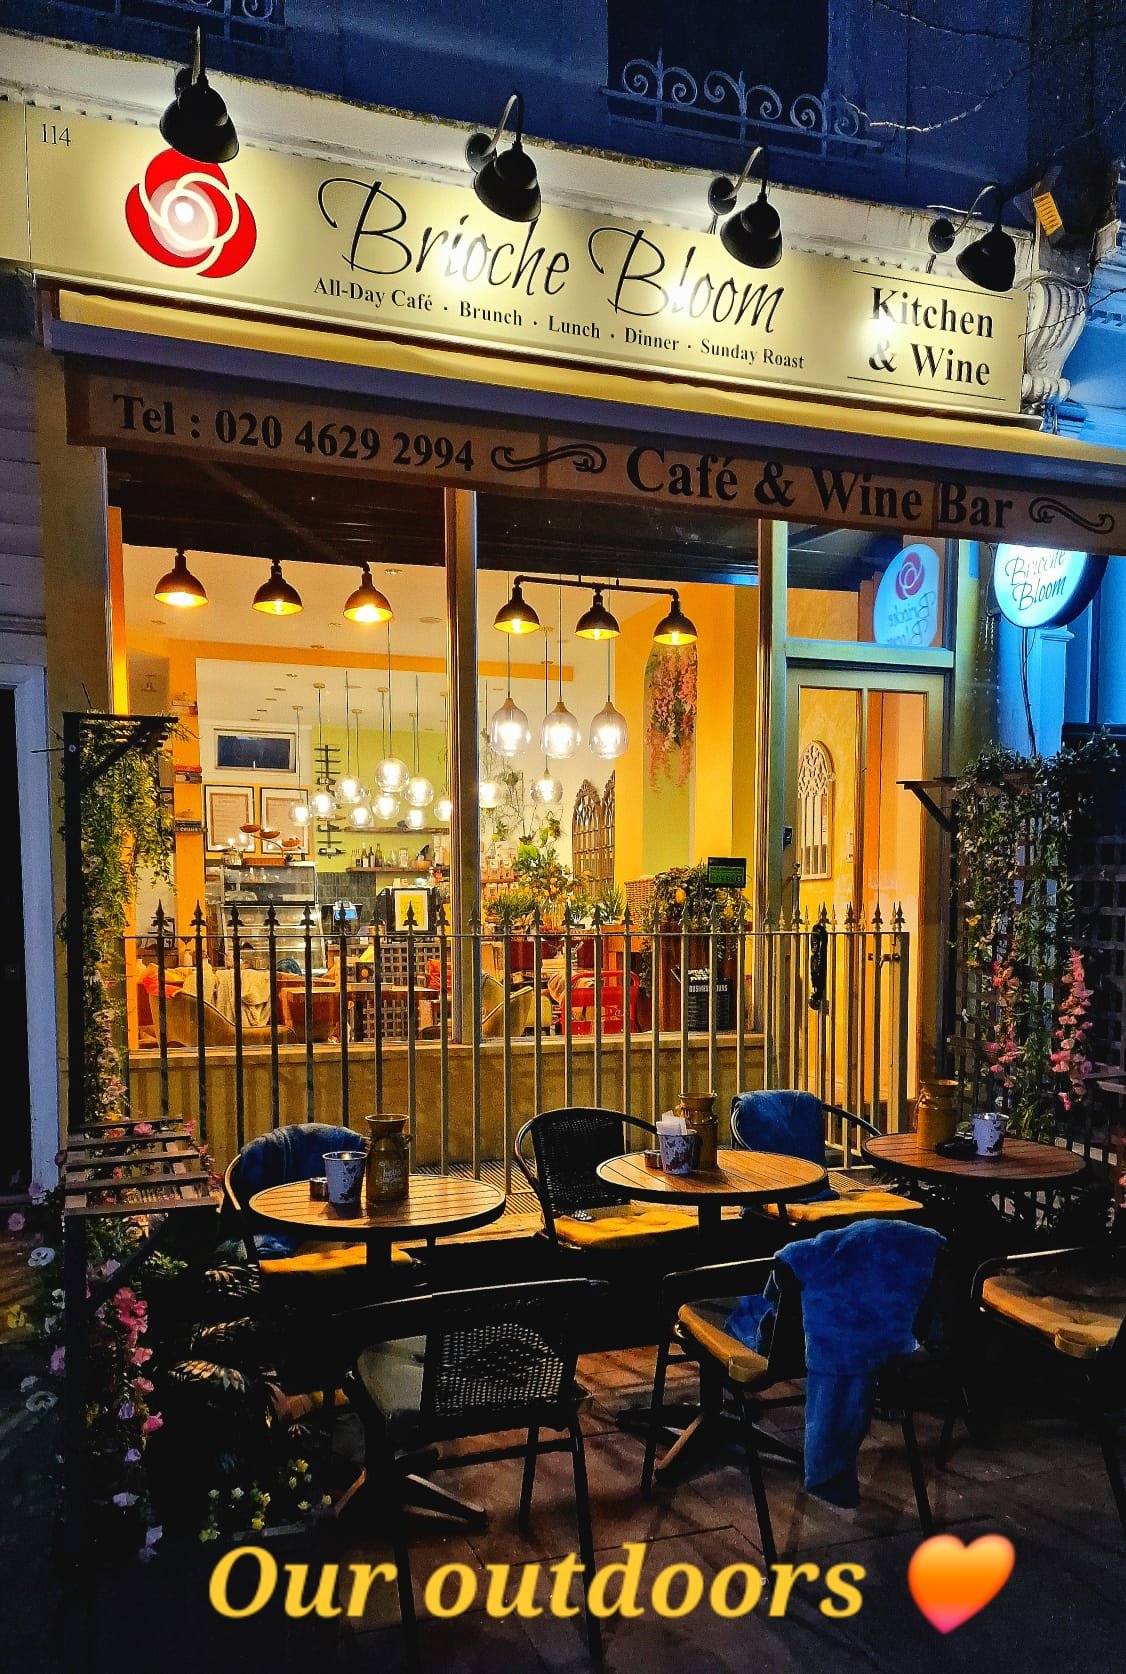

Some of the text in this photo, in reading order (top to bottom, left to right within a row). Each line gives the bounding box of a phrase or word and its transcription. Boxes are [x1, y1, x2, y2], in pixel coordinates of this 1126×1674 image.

[42, 123, 72, 147] 114
[318, 177, 785, 333] Brioche Bloom
[314, 277, 805, 369] All-Day Café Brunch Lunch Dinner Sunday Roast
[871, 286, 994, 339] Kitchen
[868, 338, 991, 386] & Wine
[214, 408, 283, 449] 020
[294, 420, 381, 461] 4629
[392, 431, 474, 472] 2994
[626, 446, 1013, 528] Café & Wine Bar
[1012, 575, 1067, 611] Bloom
